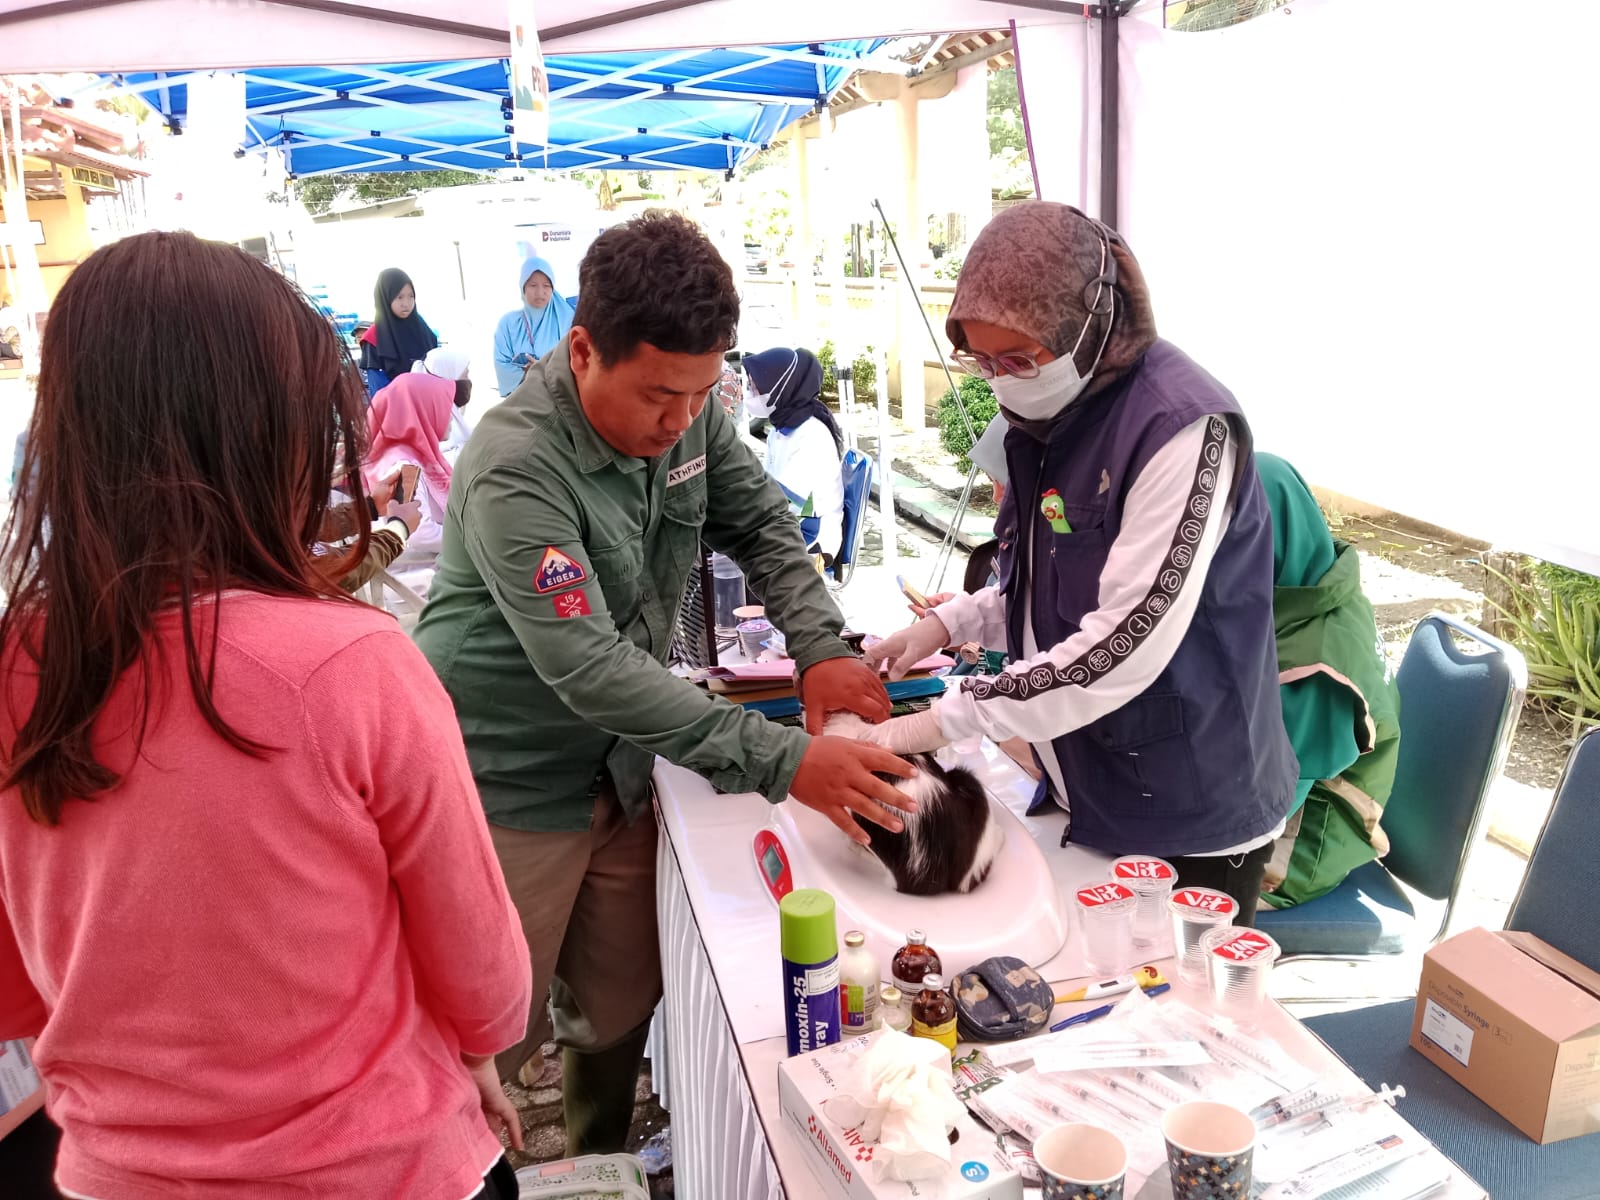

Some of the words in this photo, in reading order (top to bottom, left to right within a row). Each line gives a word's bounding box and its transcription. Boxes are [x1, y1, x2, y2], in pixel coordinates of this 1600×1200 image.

[669, 459, 706, 482] ATHFIND
[546, 571, 576, 586] EIGER
[564, 594, 575, 604] 19
[793, 976, 810, 1056] moxin-25
[1462, 1005, 1490, 1029] Syringe
[815, 1020, 830, 1049] ray
[842, 1127, 865, 1147] Alt
[816, 1129, 852, 1184] Altamed
